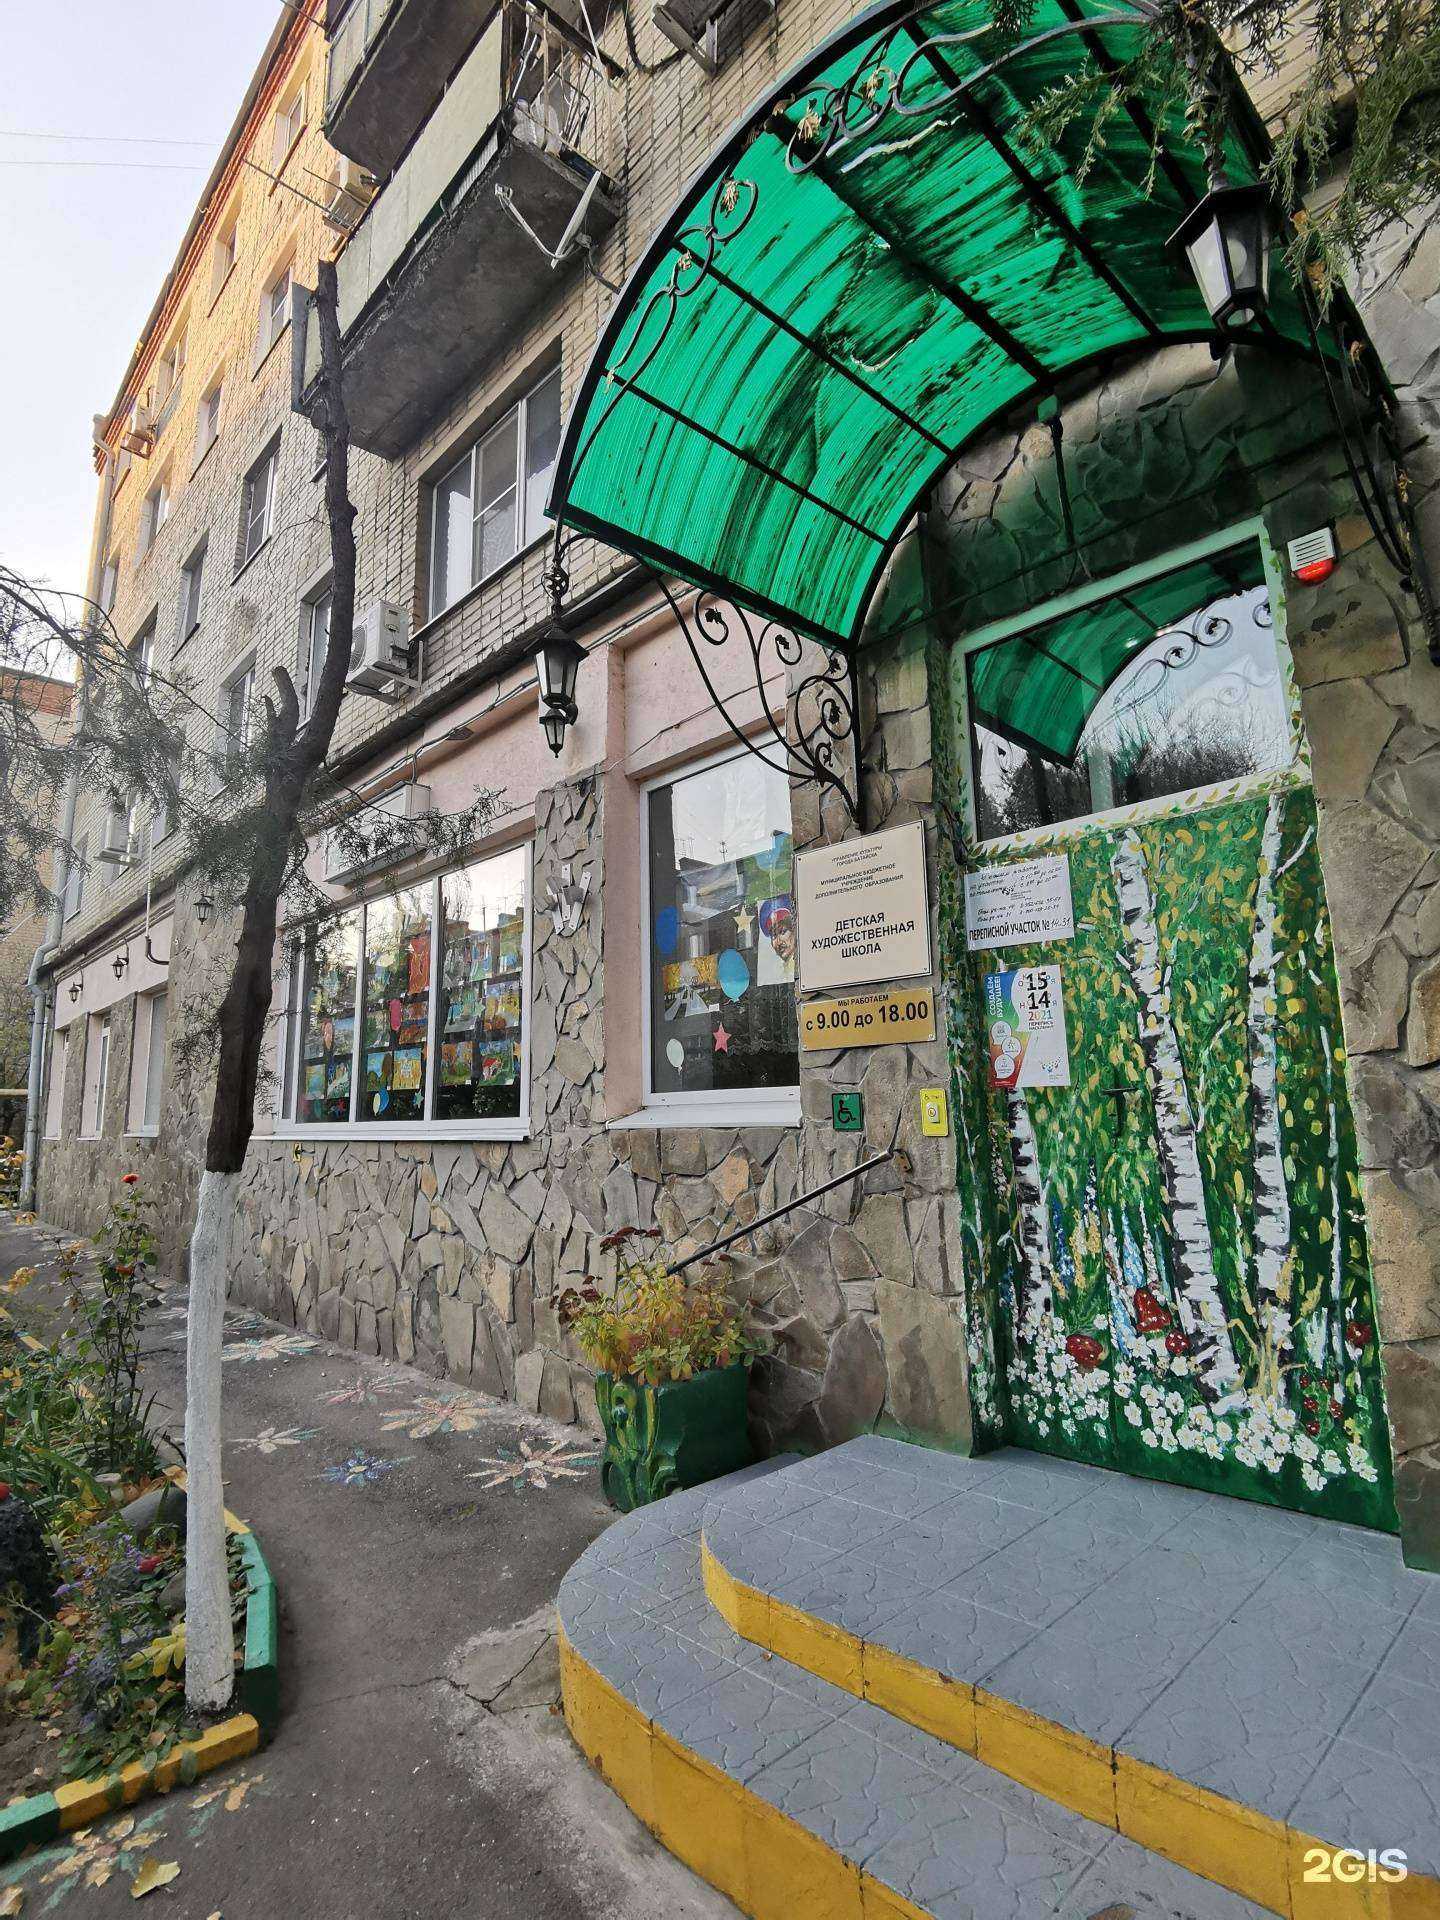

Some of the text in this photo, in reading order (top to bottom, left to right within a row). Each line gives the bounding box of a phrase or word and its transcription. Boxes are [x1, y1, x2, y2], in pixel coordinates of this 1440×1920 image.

[815, 874, 904, 899] ДОПОЛНИТЕЛЬНОГО ОБРАЗОВАНИЯ
[820, 871, 862, 886] МУНИЦИПАЛЬНОЕ
[835, 912, 885, 933] ДЕТСКАЯ
[969, 922, 1010, 941] ПЕРЕПИСНОЙ
[1010, 919, 1041, 935] УЧАСТОК
[811, 920, 915, 950] ХУДОЖЕСТВЕННАЯ
[841, 942, 882, 958] ШКОЛА
[1026, 971, 1048, 991] 15
[851, 994, 889, 1005] РАБОТАЕМ
[1027, 990, 1051, 1010] 14
[816, 1010, 850, 1030] 9.00
[854, 1013, 874, 1029] до
[878, 1000, 928, 1023] 18.00
[1028, 1010, 1053, 1021] 2021
